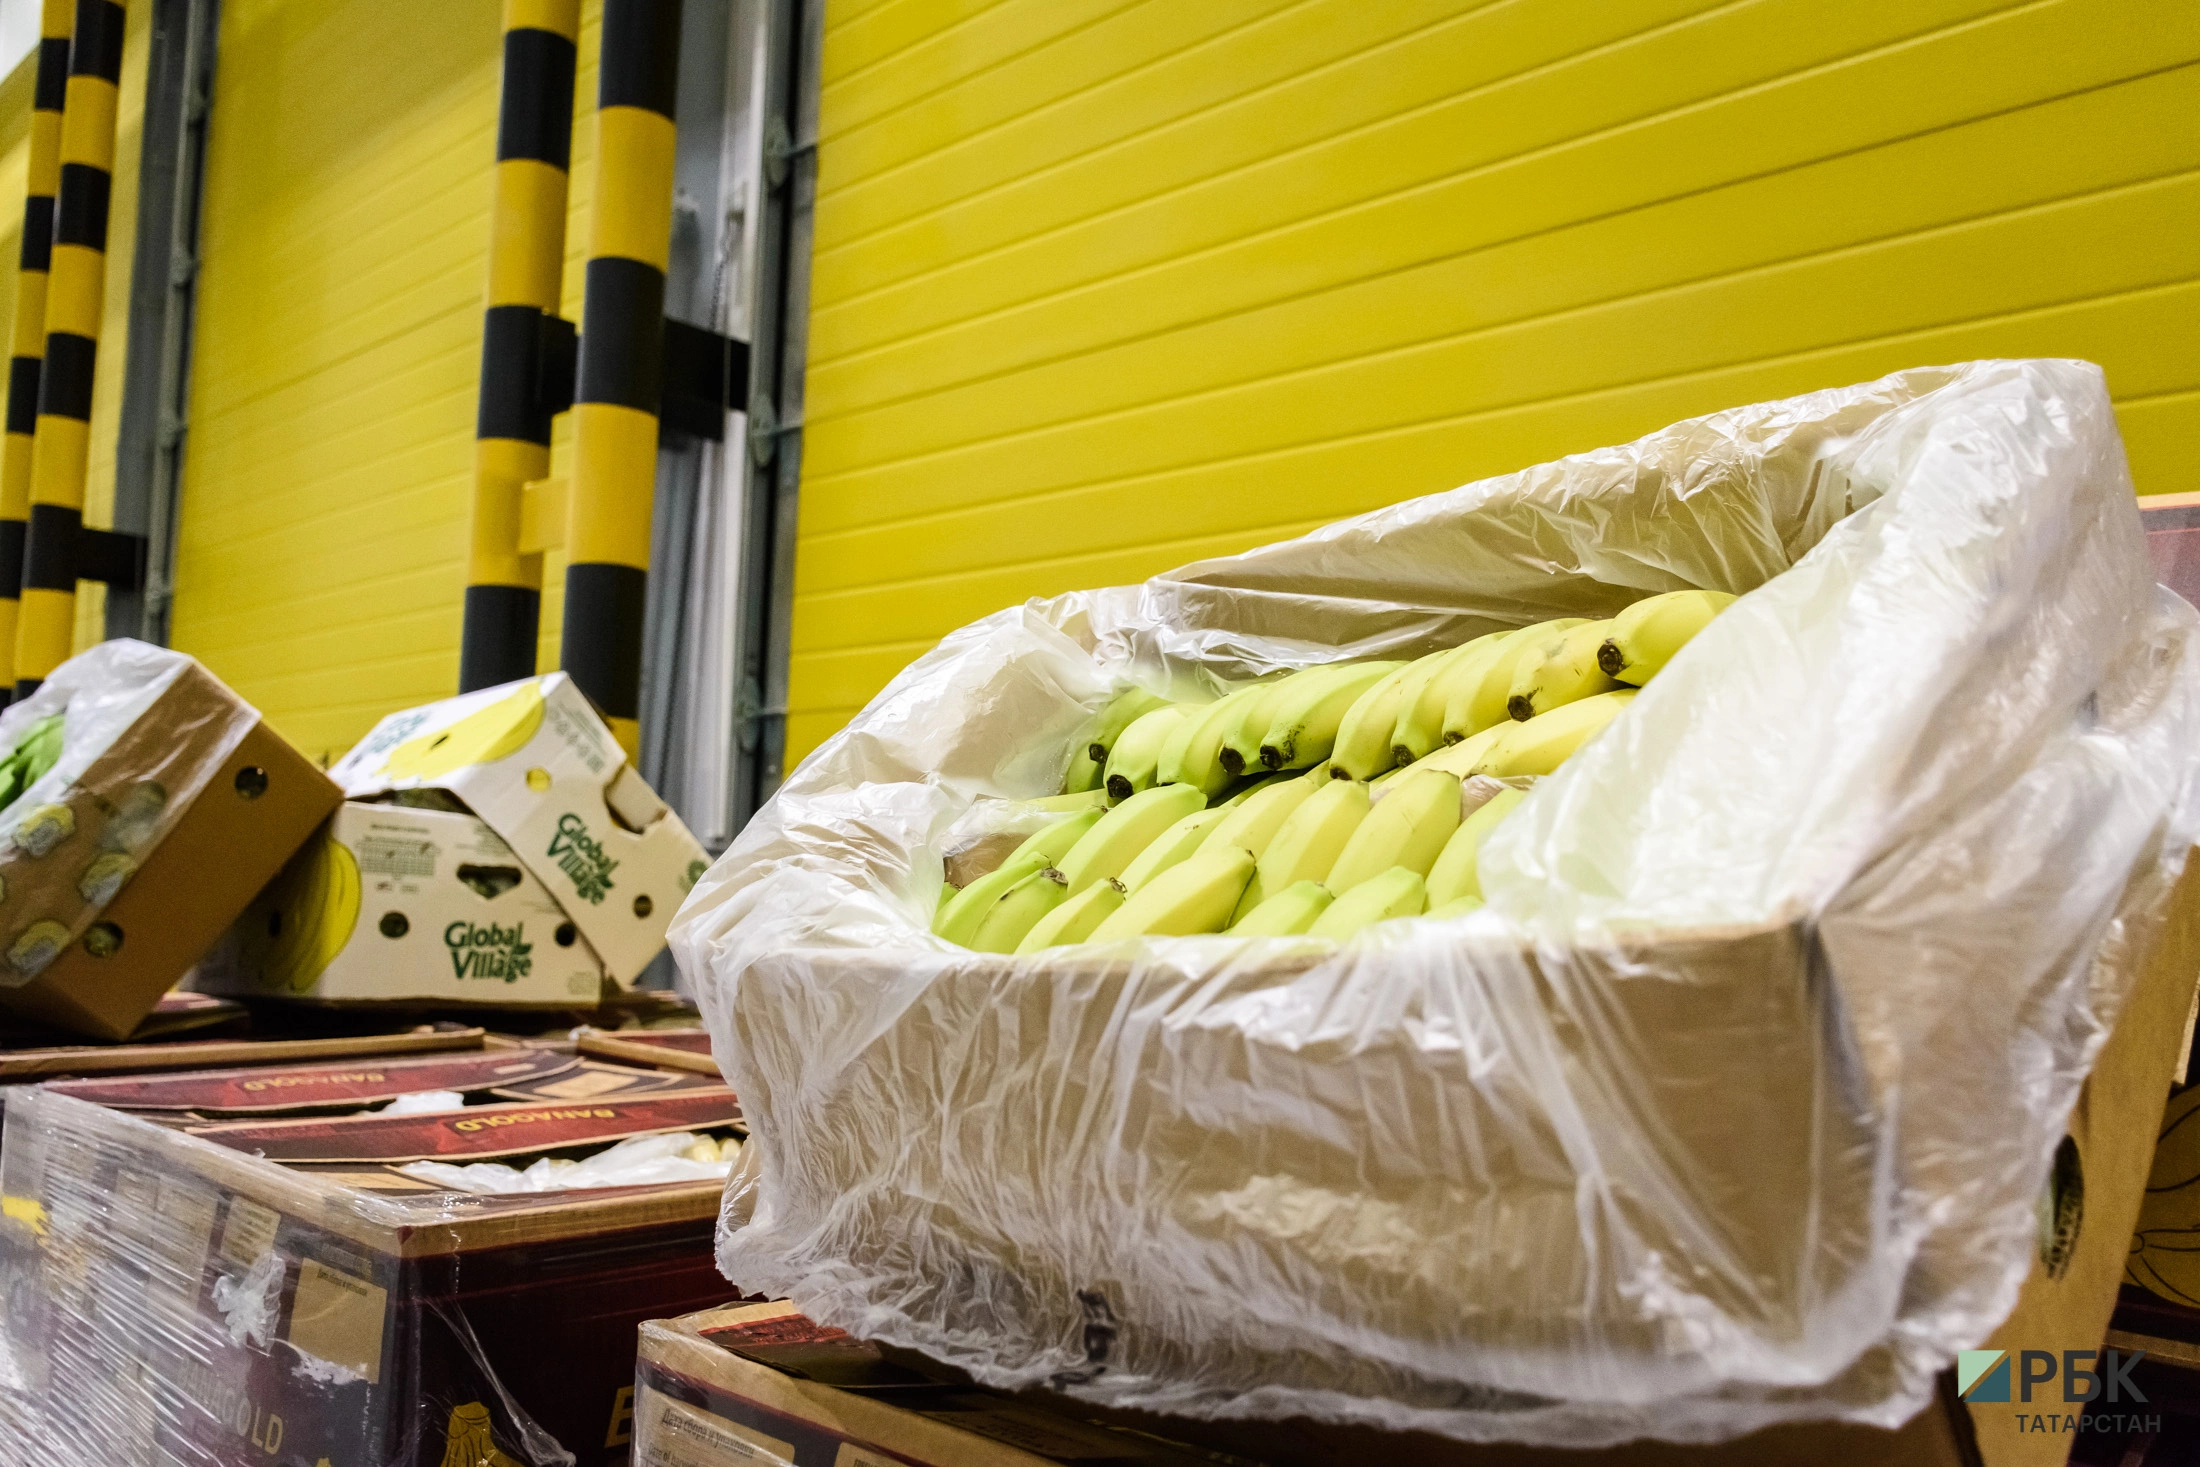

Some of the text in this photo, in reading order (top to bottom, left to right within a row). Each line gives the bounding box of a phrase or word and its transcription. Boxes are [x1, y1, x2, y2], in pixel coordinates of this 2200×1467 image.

[558, 812, 619, 876] Global
[547, 832, 606, 906] Village
[444, 920, 524, 949] Global
[451, 949, 534, 984] Village
[454, 1108, 615, 1132] BANAGOLD
[661, 1407, 683, 1430] Дата
[683, 1419, 708, 1441] сбора
